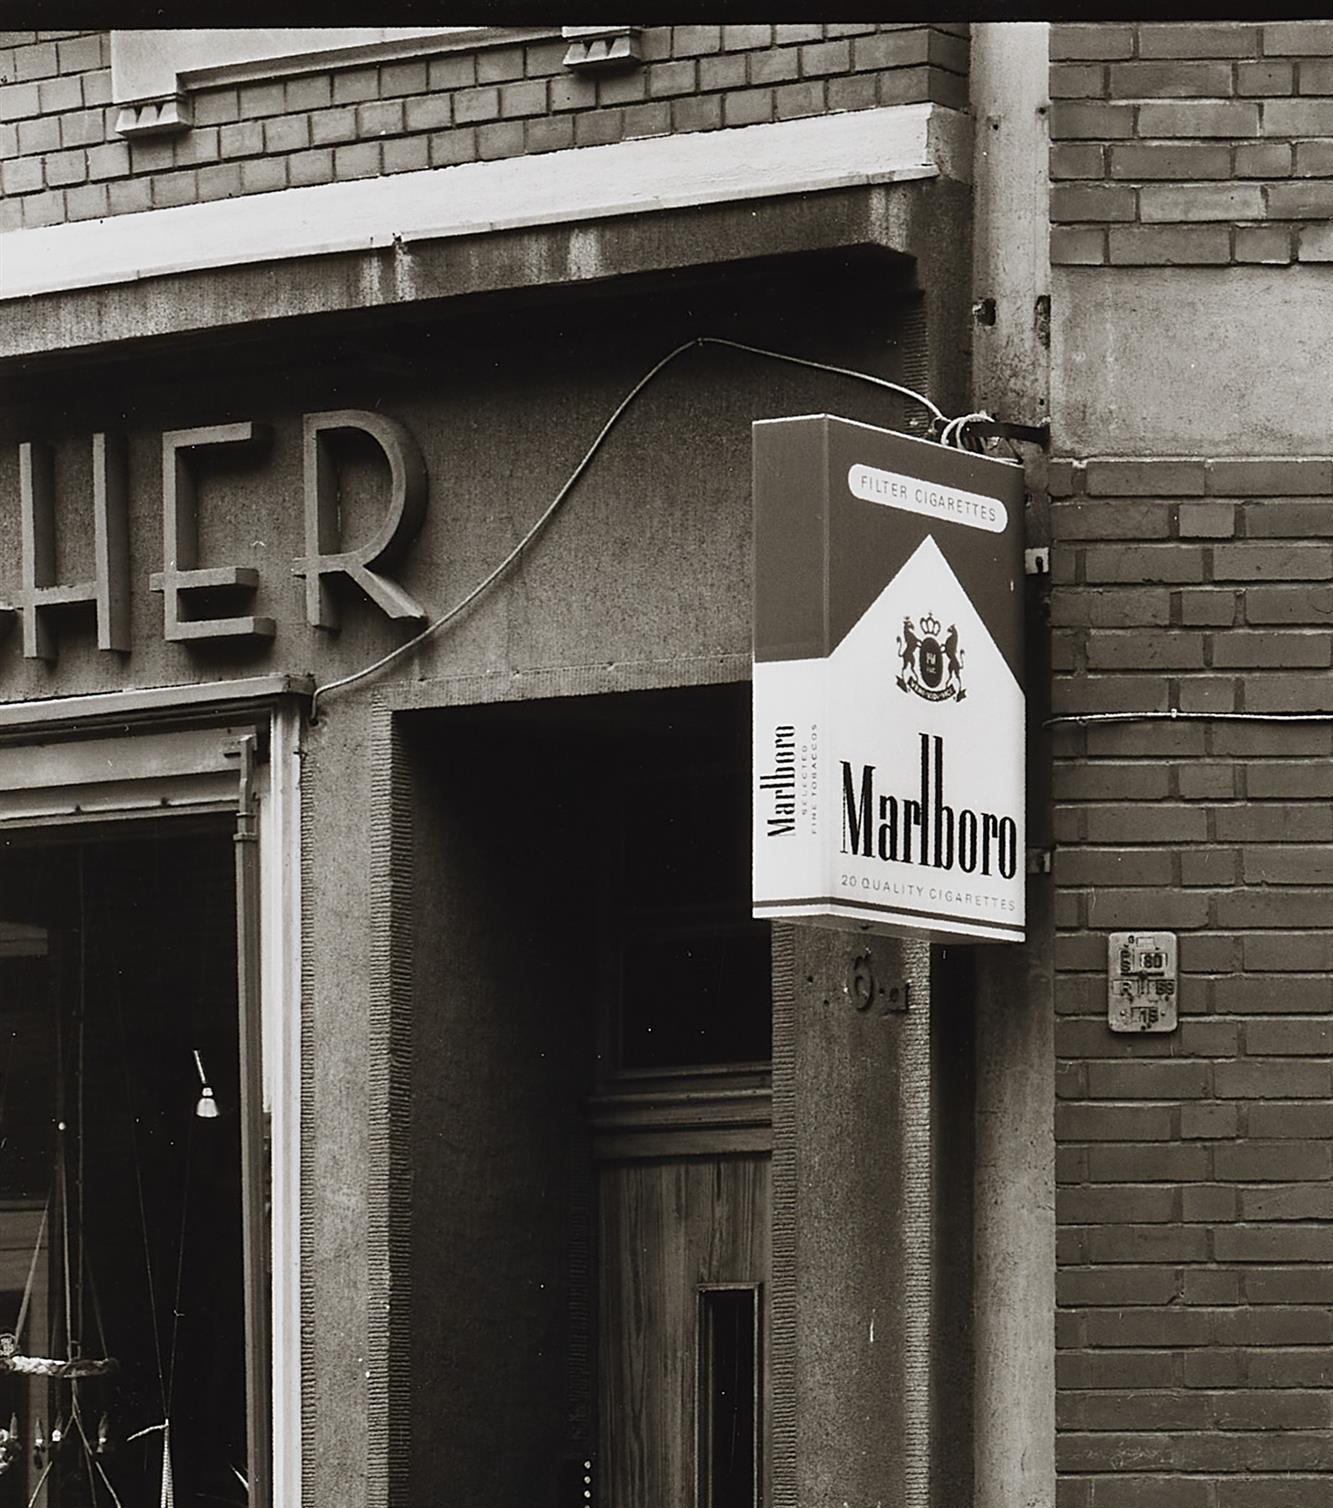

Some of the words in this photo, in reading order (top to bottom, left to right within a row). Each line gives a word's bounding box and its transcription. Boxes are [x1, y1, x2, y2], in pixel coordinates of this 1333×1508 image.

[860, 474, 908, 500] FILTER
[914, 487, 997, 524] CIGARETTES
[759, 725, 796, 836] Marlboro
[839, 733, 1018, 880] Marlboro
[841, 873, 858, 889] 20
[860, 875, 925, 899] QUALITY
[928, 887, 1017, 913] CIGARETTES
